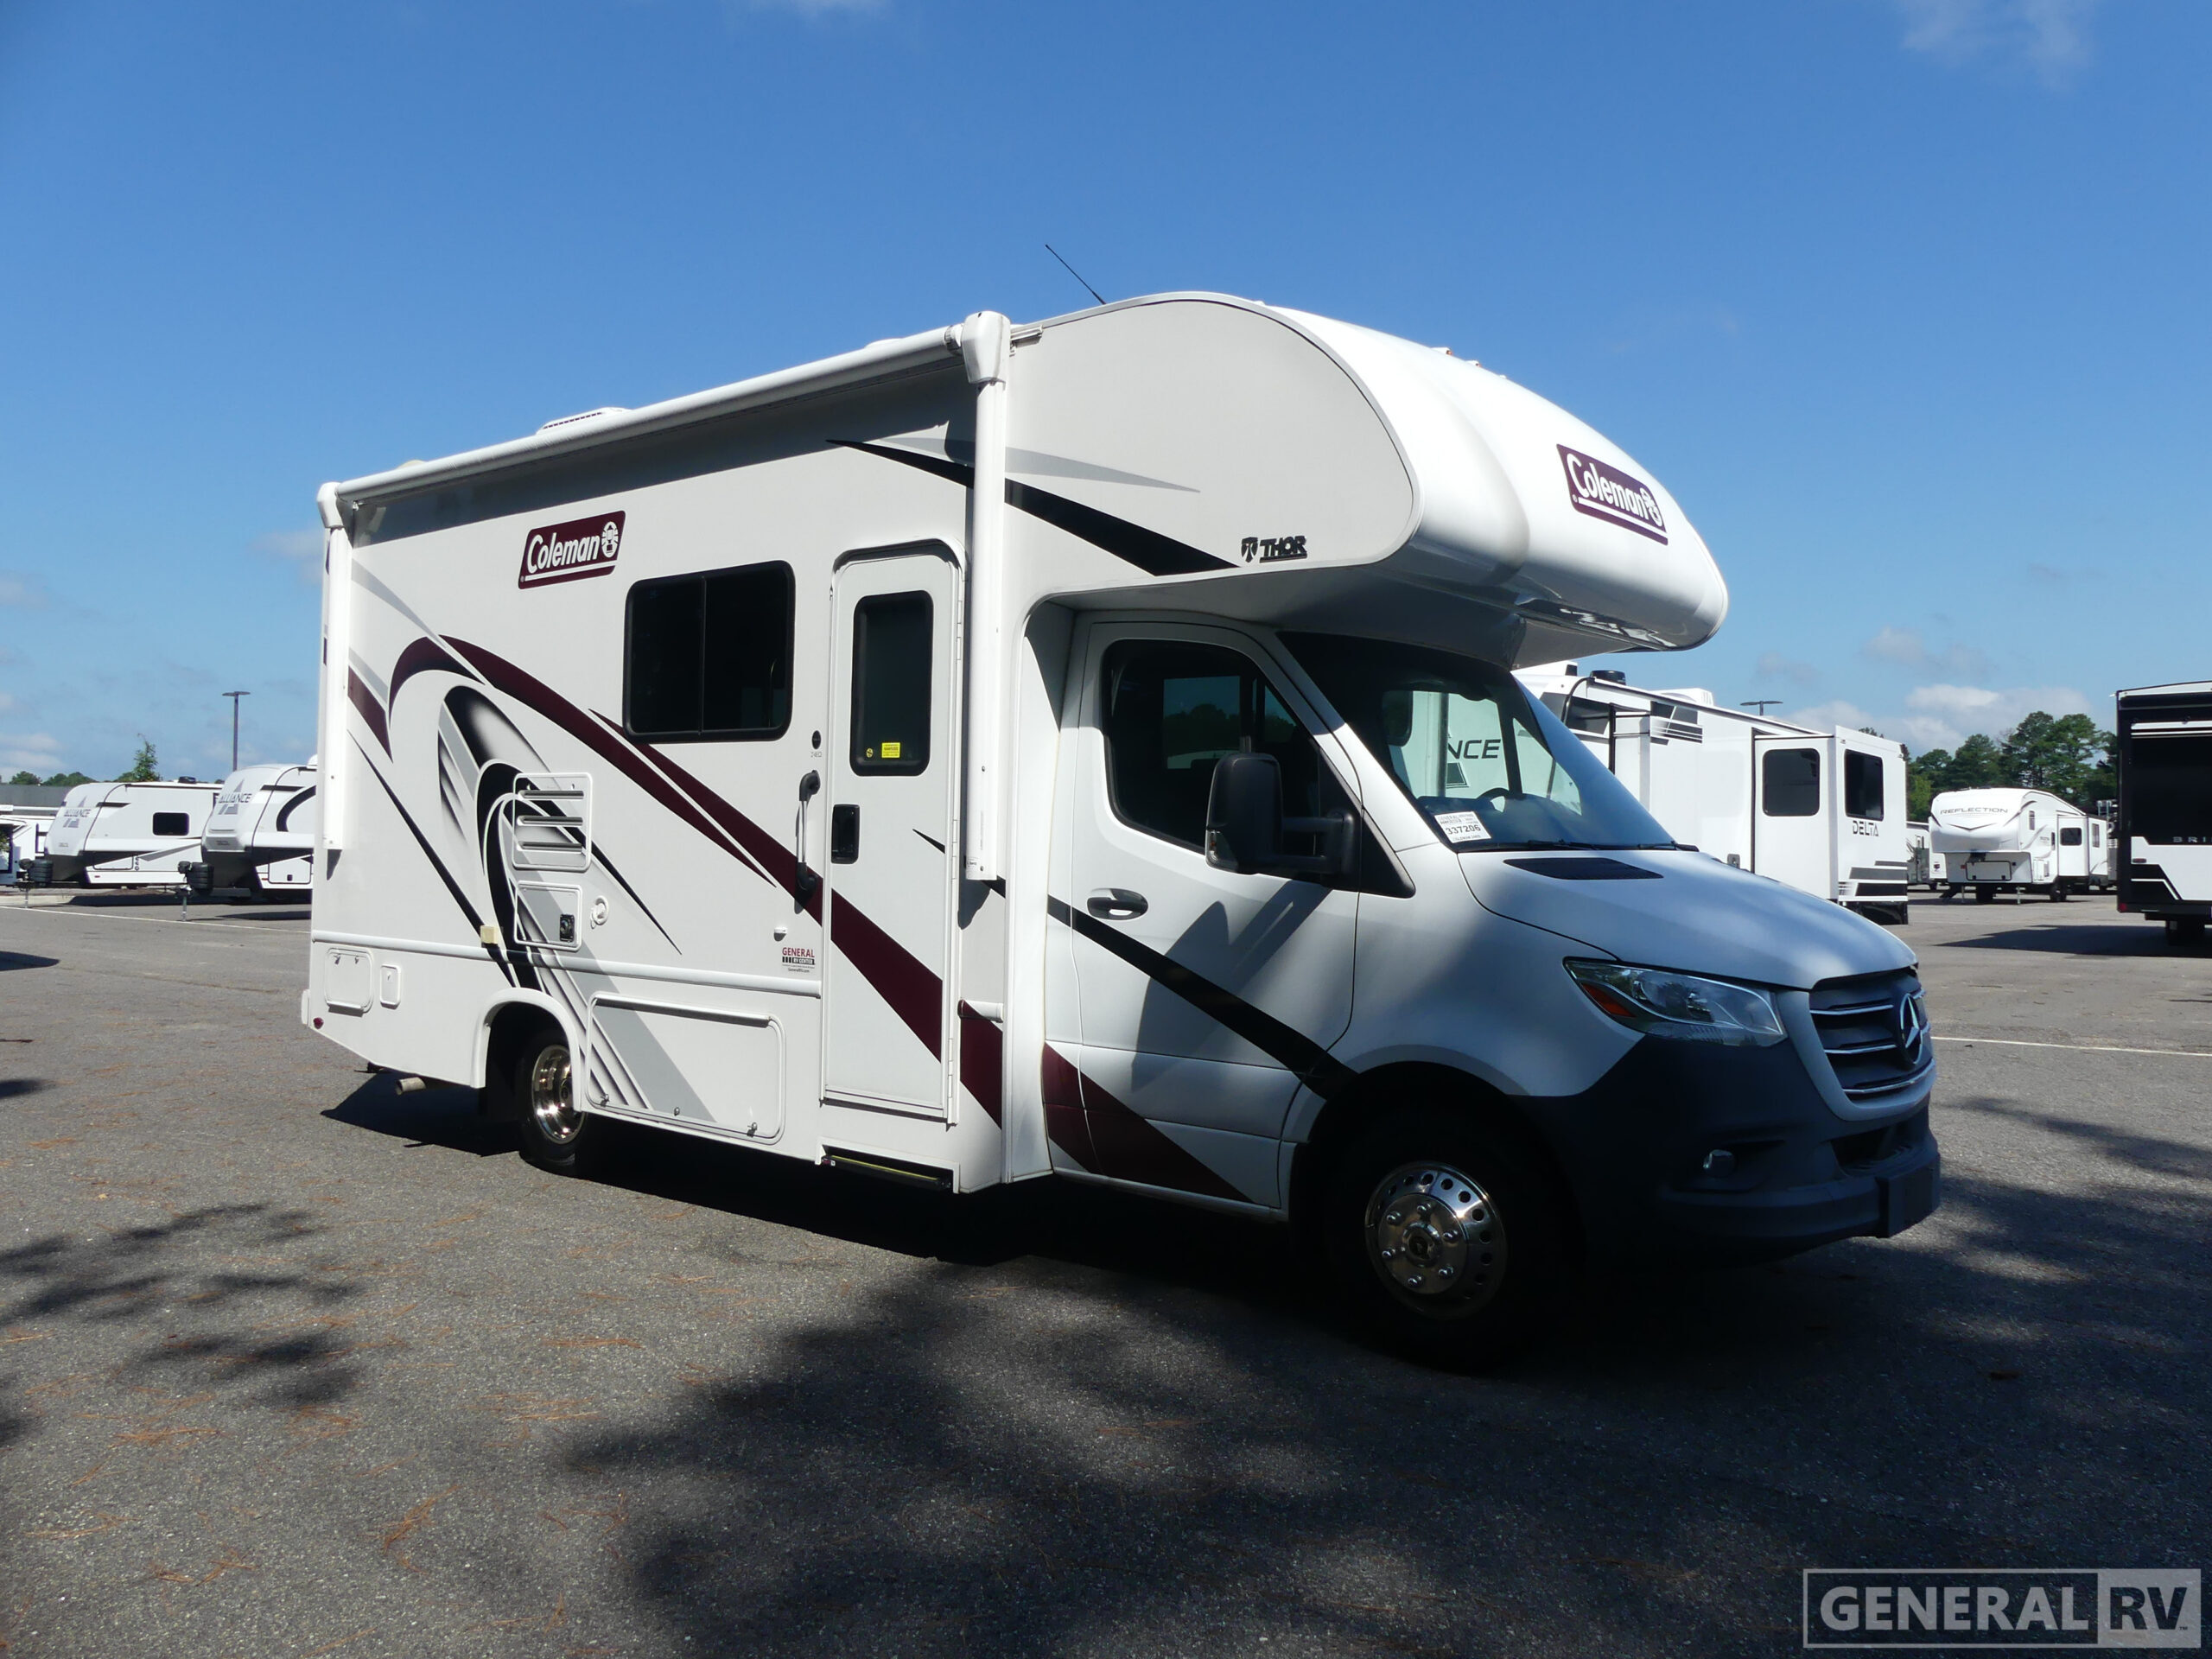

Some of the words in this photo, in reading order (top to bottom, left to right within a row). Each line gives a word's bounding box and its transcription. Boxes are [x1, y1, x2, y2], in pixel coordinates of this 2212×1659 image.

[1567, 453, 1649, 520] Coleman
[527, 532, 601, 574] Coleman
[1260, 536, 1307, 557] THOR
[1446, 824, 1481, 835] 337206
[1853, 820, 1879, 836] DELTA
[782, 947, 815, 957] GENERAL
